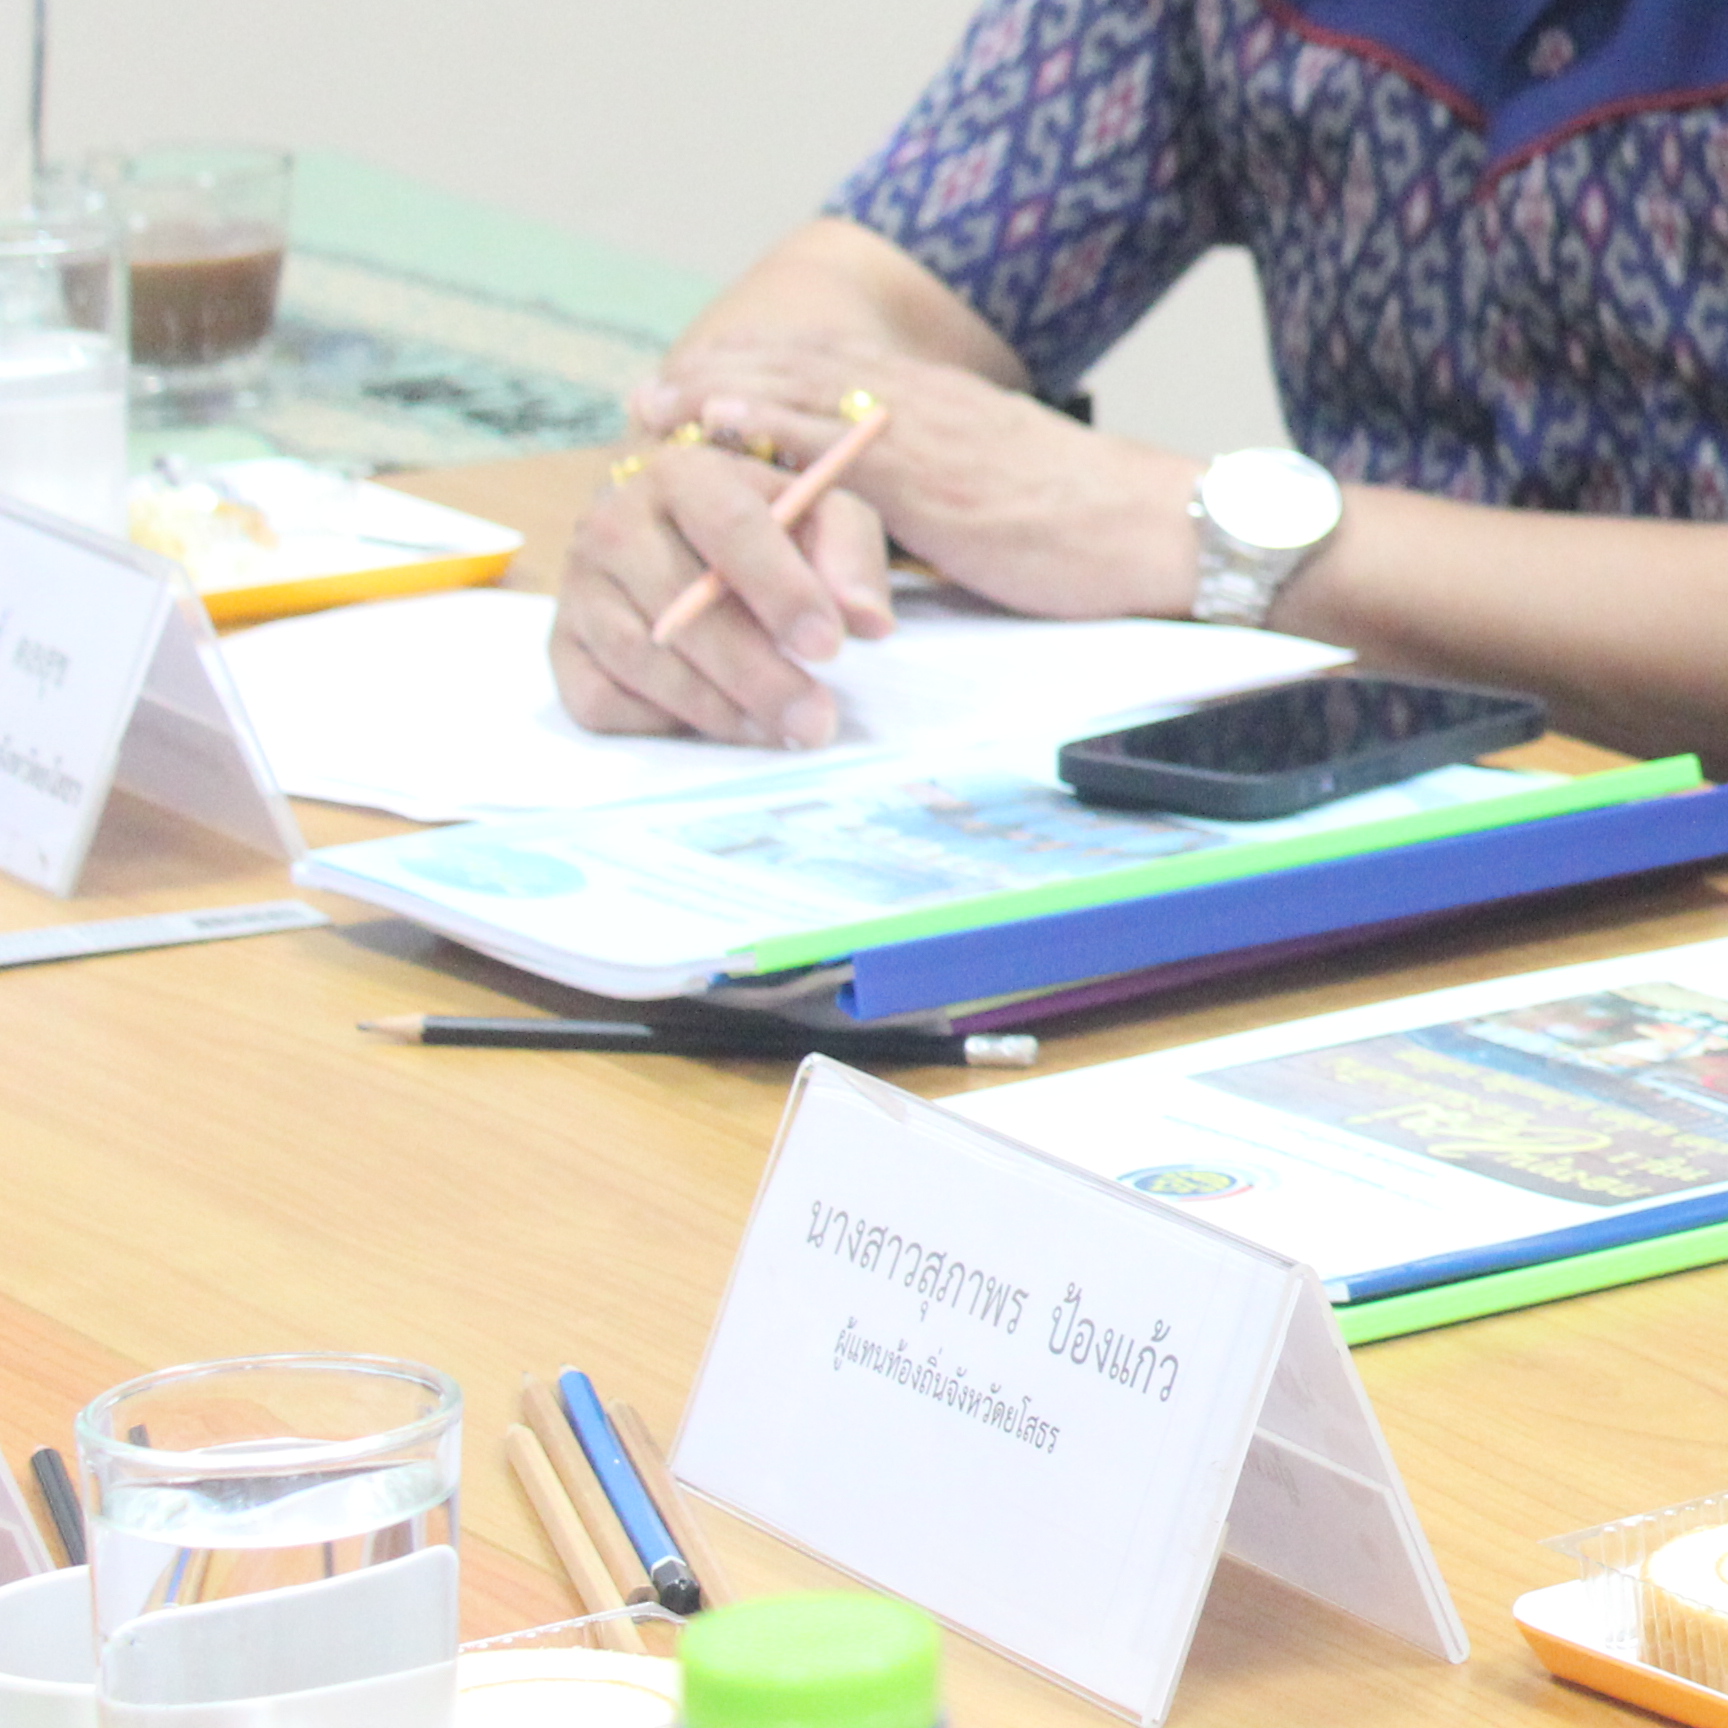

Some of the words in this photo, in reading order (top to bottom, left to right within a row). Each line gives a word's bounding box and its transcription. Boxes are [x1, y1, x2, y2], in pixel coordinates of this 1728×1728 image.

[806, 1200, 1030, 1335] นางสาวสุภาพร
[1047, 1281, 1180, 1403] ป้องแก้ว
[833, 1315, 1062, 1455] ผู้แทนท้องถิ่นจังหวัดยโสธร
